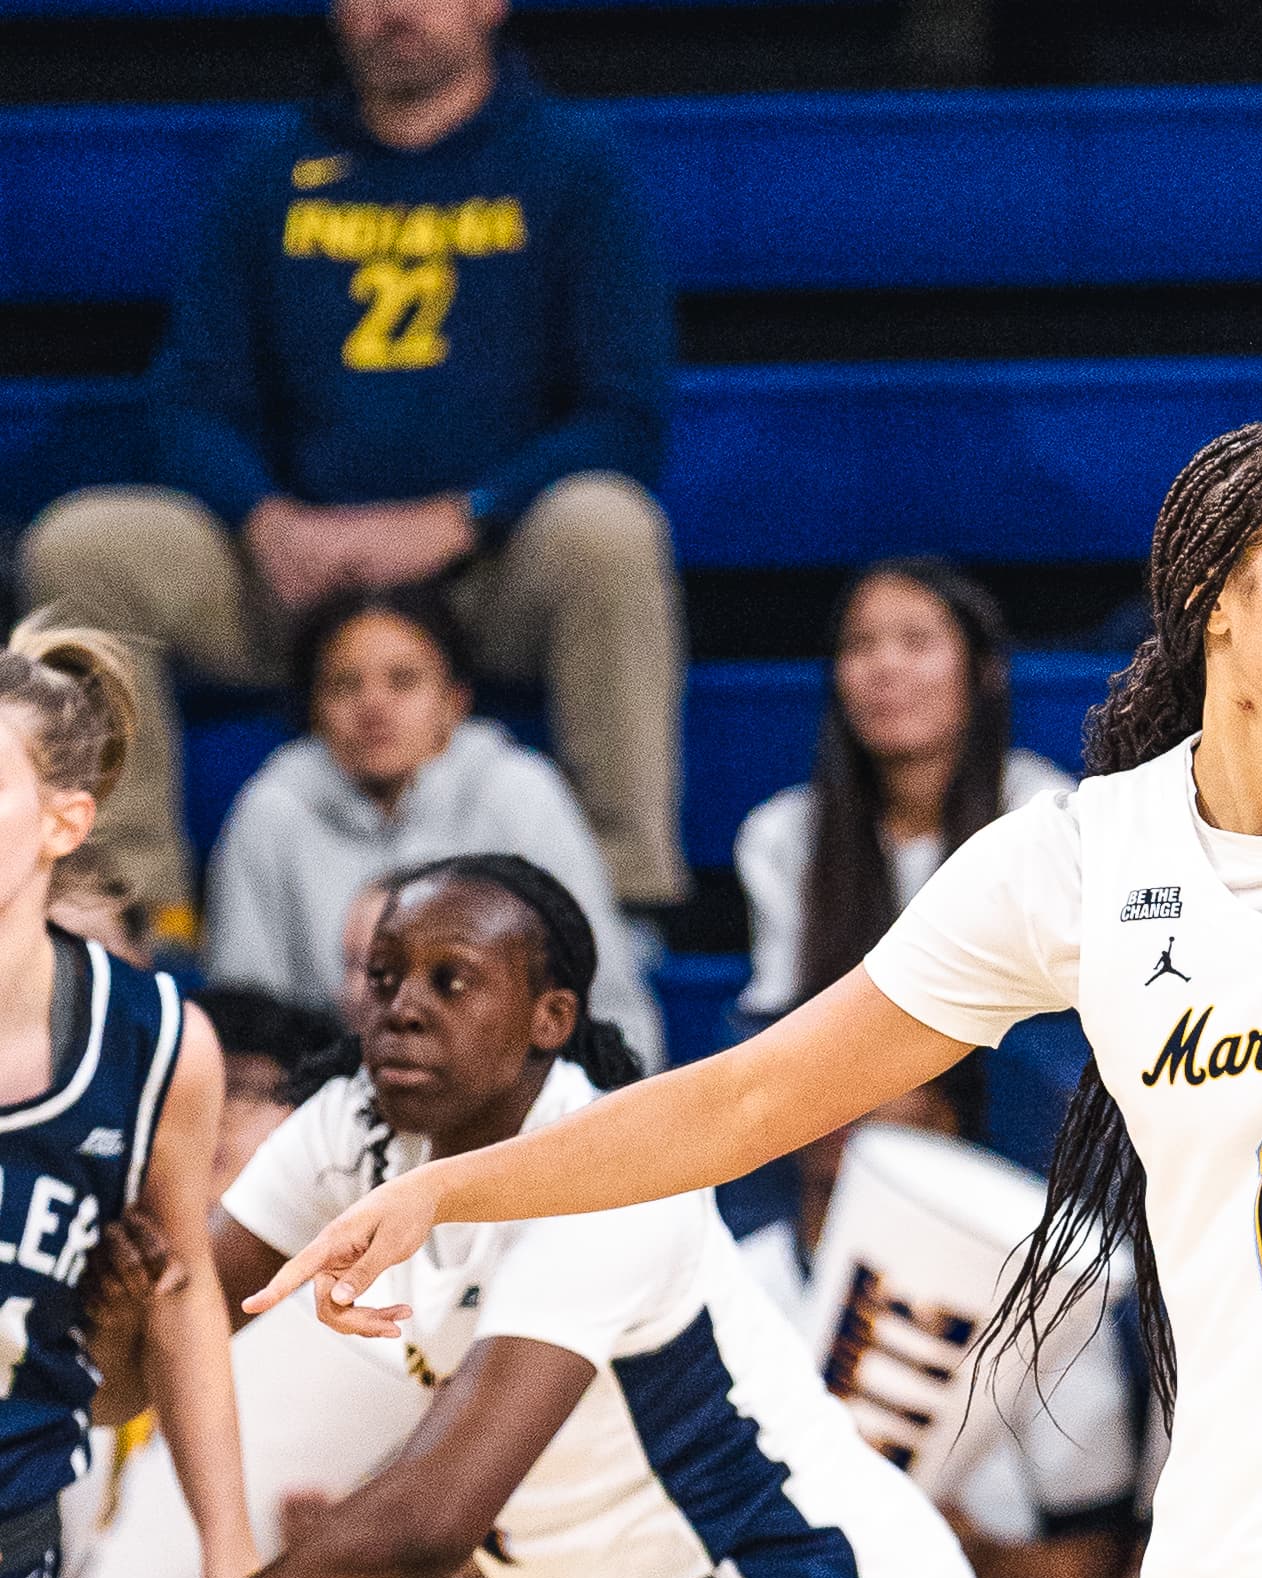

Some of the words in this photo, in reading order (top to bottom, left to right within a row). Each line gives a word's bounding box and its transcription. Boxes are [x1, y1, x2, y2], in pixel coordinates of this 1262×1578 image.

[340, 261, 459, 371] 22
[1127, 889, 1148, 905] BE
[1150, 887, 1181, 903] THE
[1120, 902, 1182, 921] CHANGE
